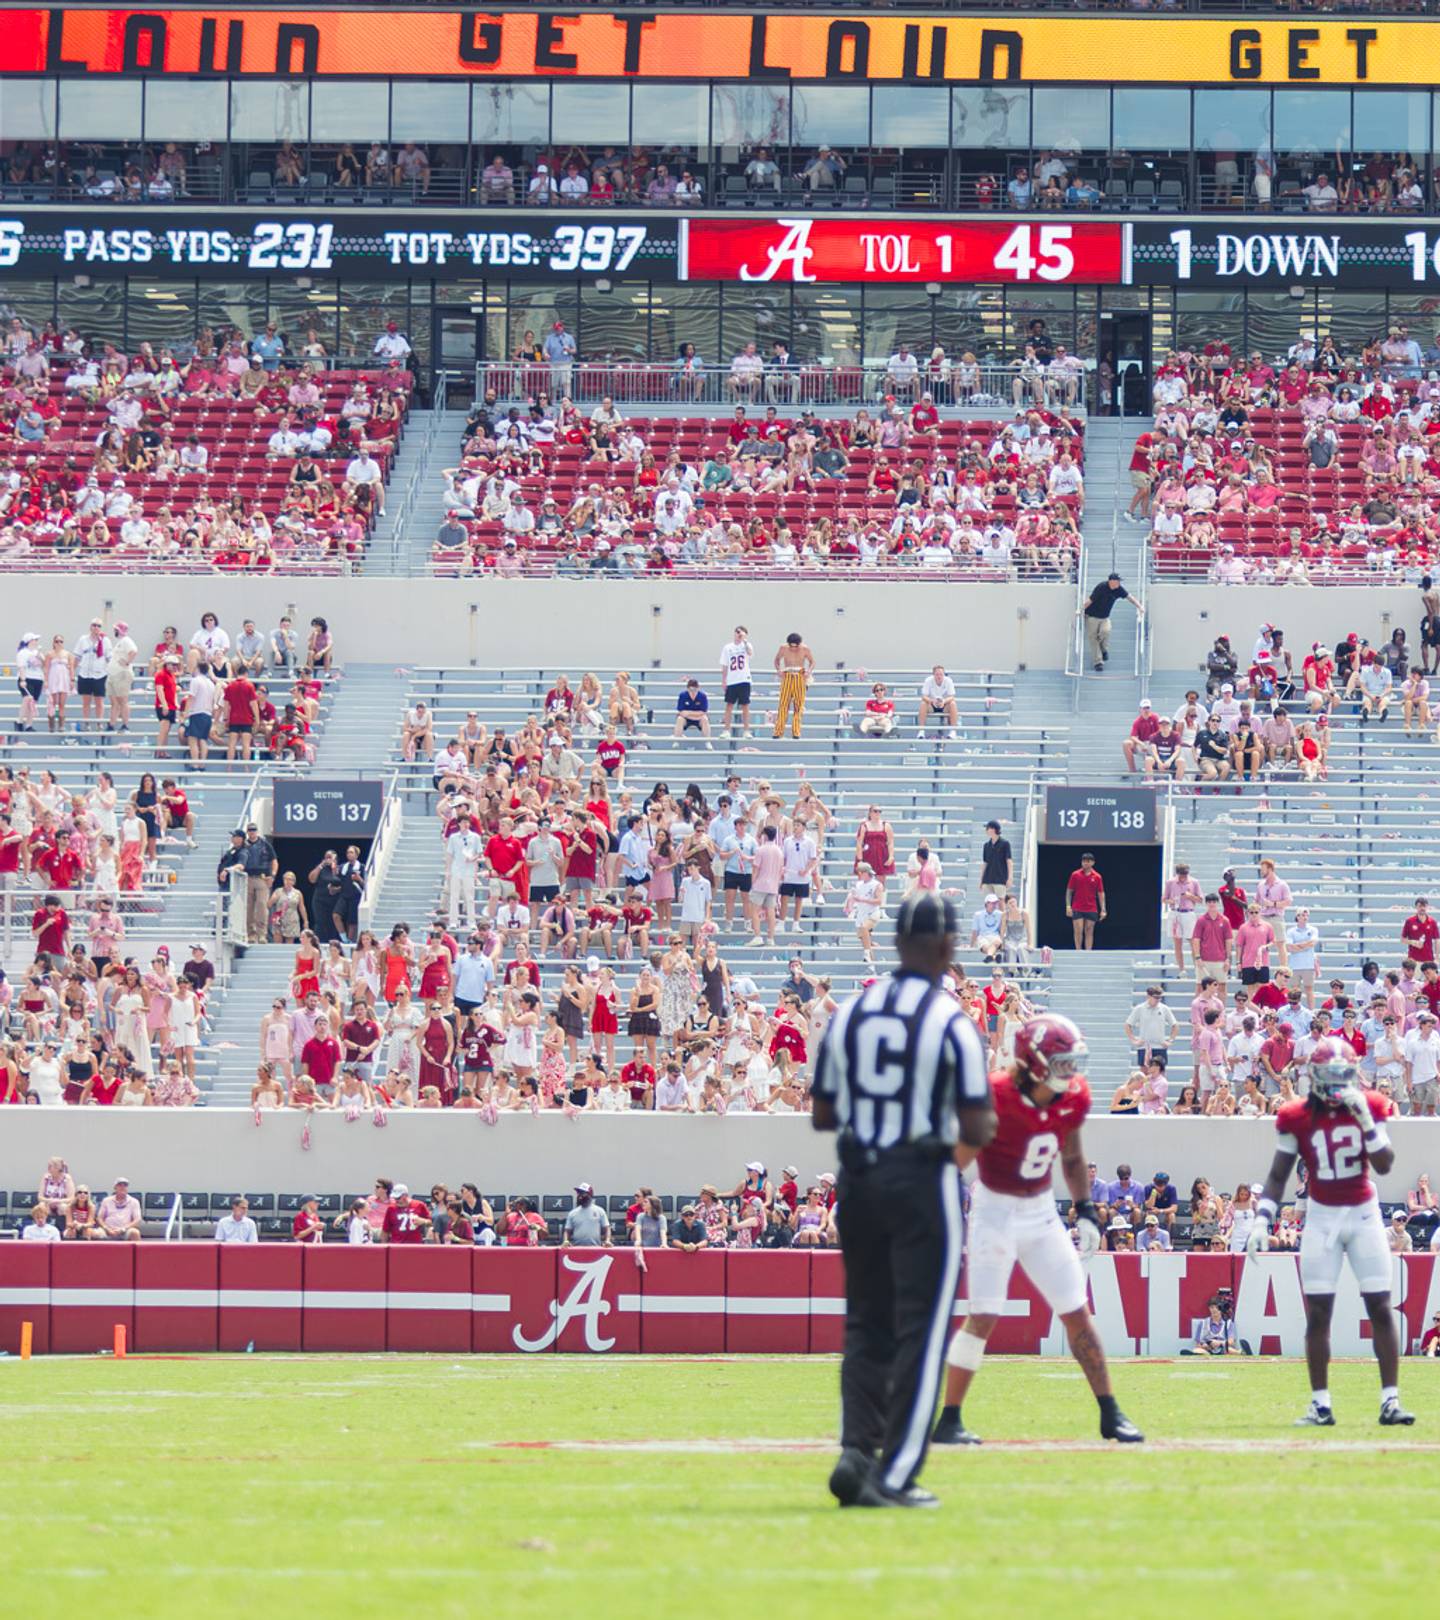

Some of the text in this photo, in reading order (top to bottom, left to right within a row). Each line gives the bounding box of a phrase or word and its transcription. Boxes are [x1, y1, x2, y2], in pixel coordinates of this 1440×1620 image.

[459, 13, 1023, 79] GET LOUD
[1230, 28, 1377, 79] GET
[64, 224, 333, 268] PASS YDS: 231
[384, 226, 647, 271] TOT YDS: 397
[860, 235, 952, 272] TOL 1
[993, 225, 1075, 280] 45
[1169, 230, 1340, 279] 1 DOWN
[730, 655, 745, 671] 26
[284, 803, 318, 821] 136
[313, 791, 343, 799] SECTION
[338, 803, 371, 821] 137
[1087, 798, 1117, 806] SECTION
[1058, 809, 1090, 828] 137
[1111, 811, 1145, 829] 138
[468, 1043, 479, 1059] 2
[856, 1015, 908, 1095] C
[1019, 1132, 1059, 1180] 8
[1310, 1124, 1362, 1180] 12
[512, 1254, 616, 1352] A
